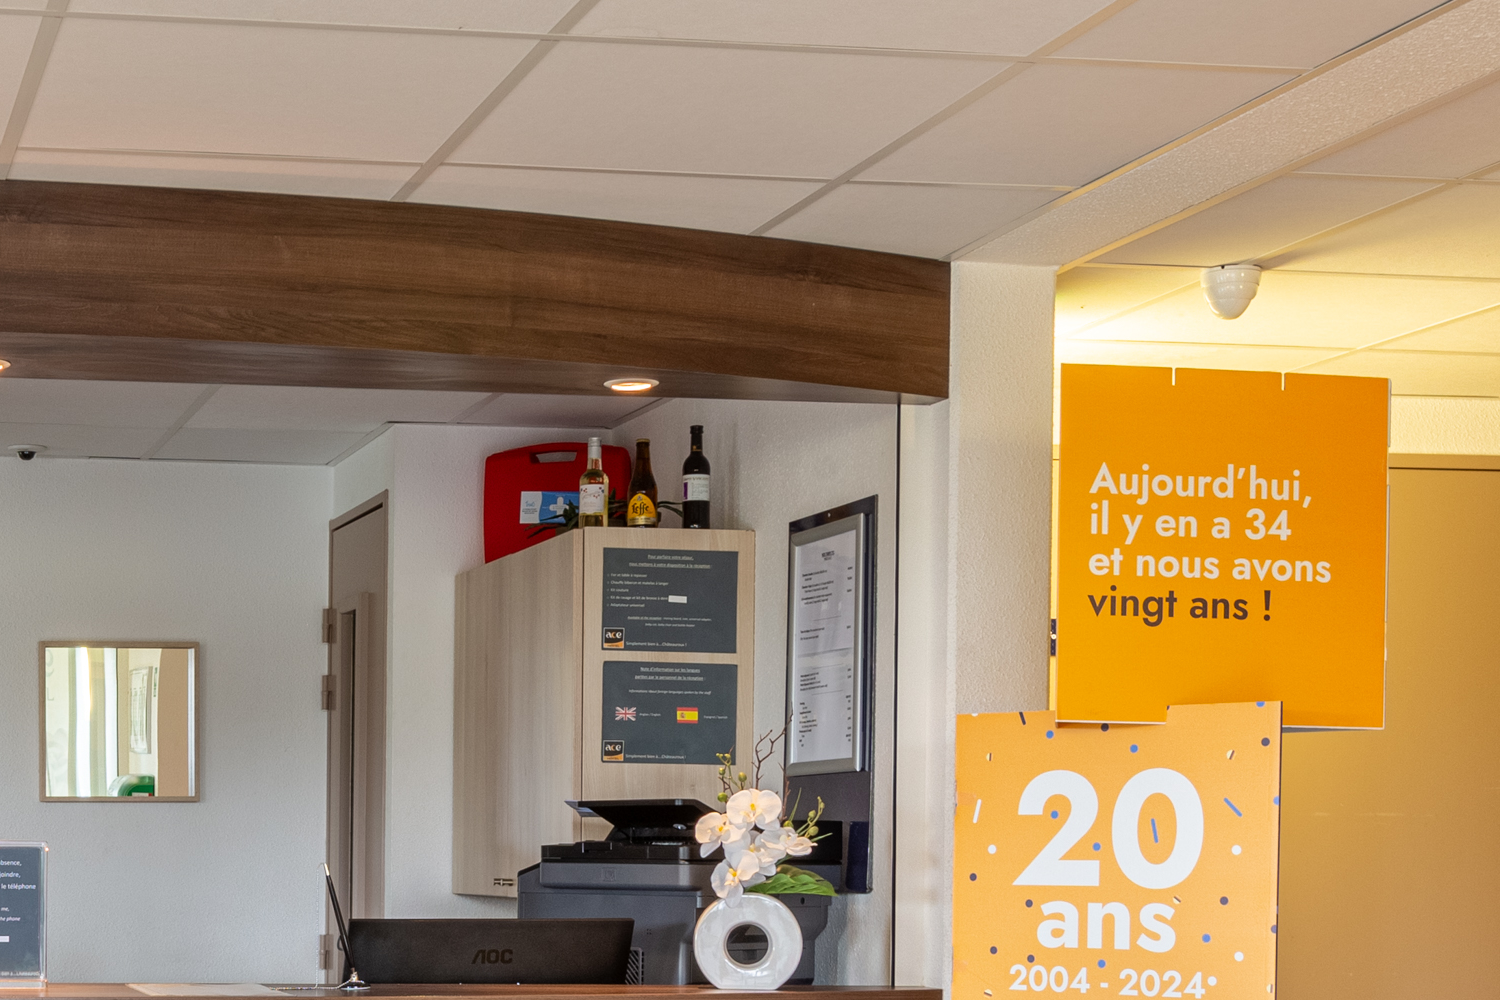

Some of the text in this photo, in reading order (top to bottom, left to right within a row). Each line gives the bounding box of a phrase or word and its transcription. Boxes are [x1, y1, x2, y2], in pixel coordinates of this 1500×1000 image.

[1089, 462, 1312, 508] Aujourd'hui,
[632, 502, 649, 516] Leffe
[1090, 500, 1292, 545] il y en a 34
[1088, 548, 1332, 583] et nous avons
[1087, 585, 1272, 627] vingt ans !
[605, 631, 622, 639] ace
[605, 744, 622, 752] ace
[1011, 767, 1205, 890] 20
[0, 871, 21, 879] joindre,
[1036, 900, 1177, 953] ans
[471, 949, 513, 964] AOC
[1009, 964, 1206, 1000] 2004 - 2024
